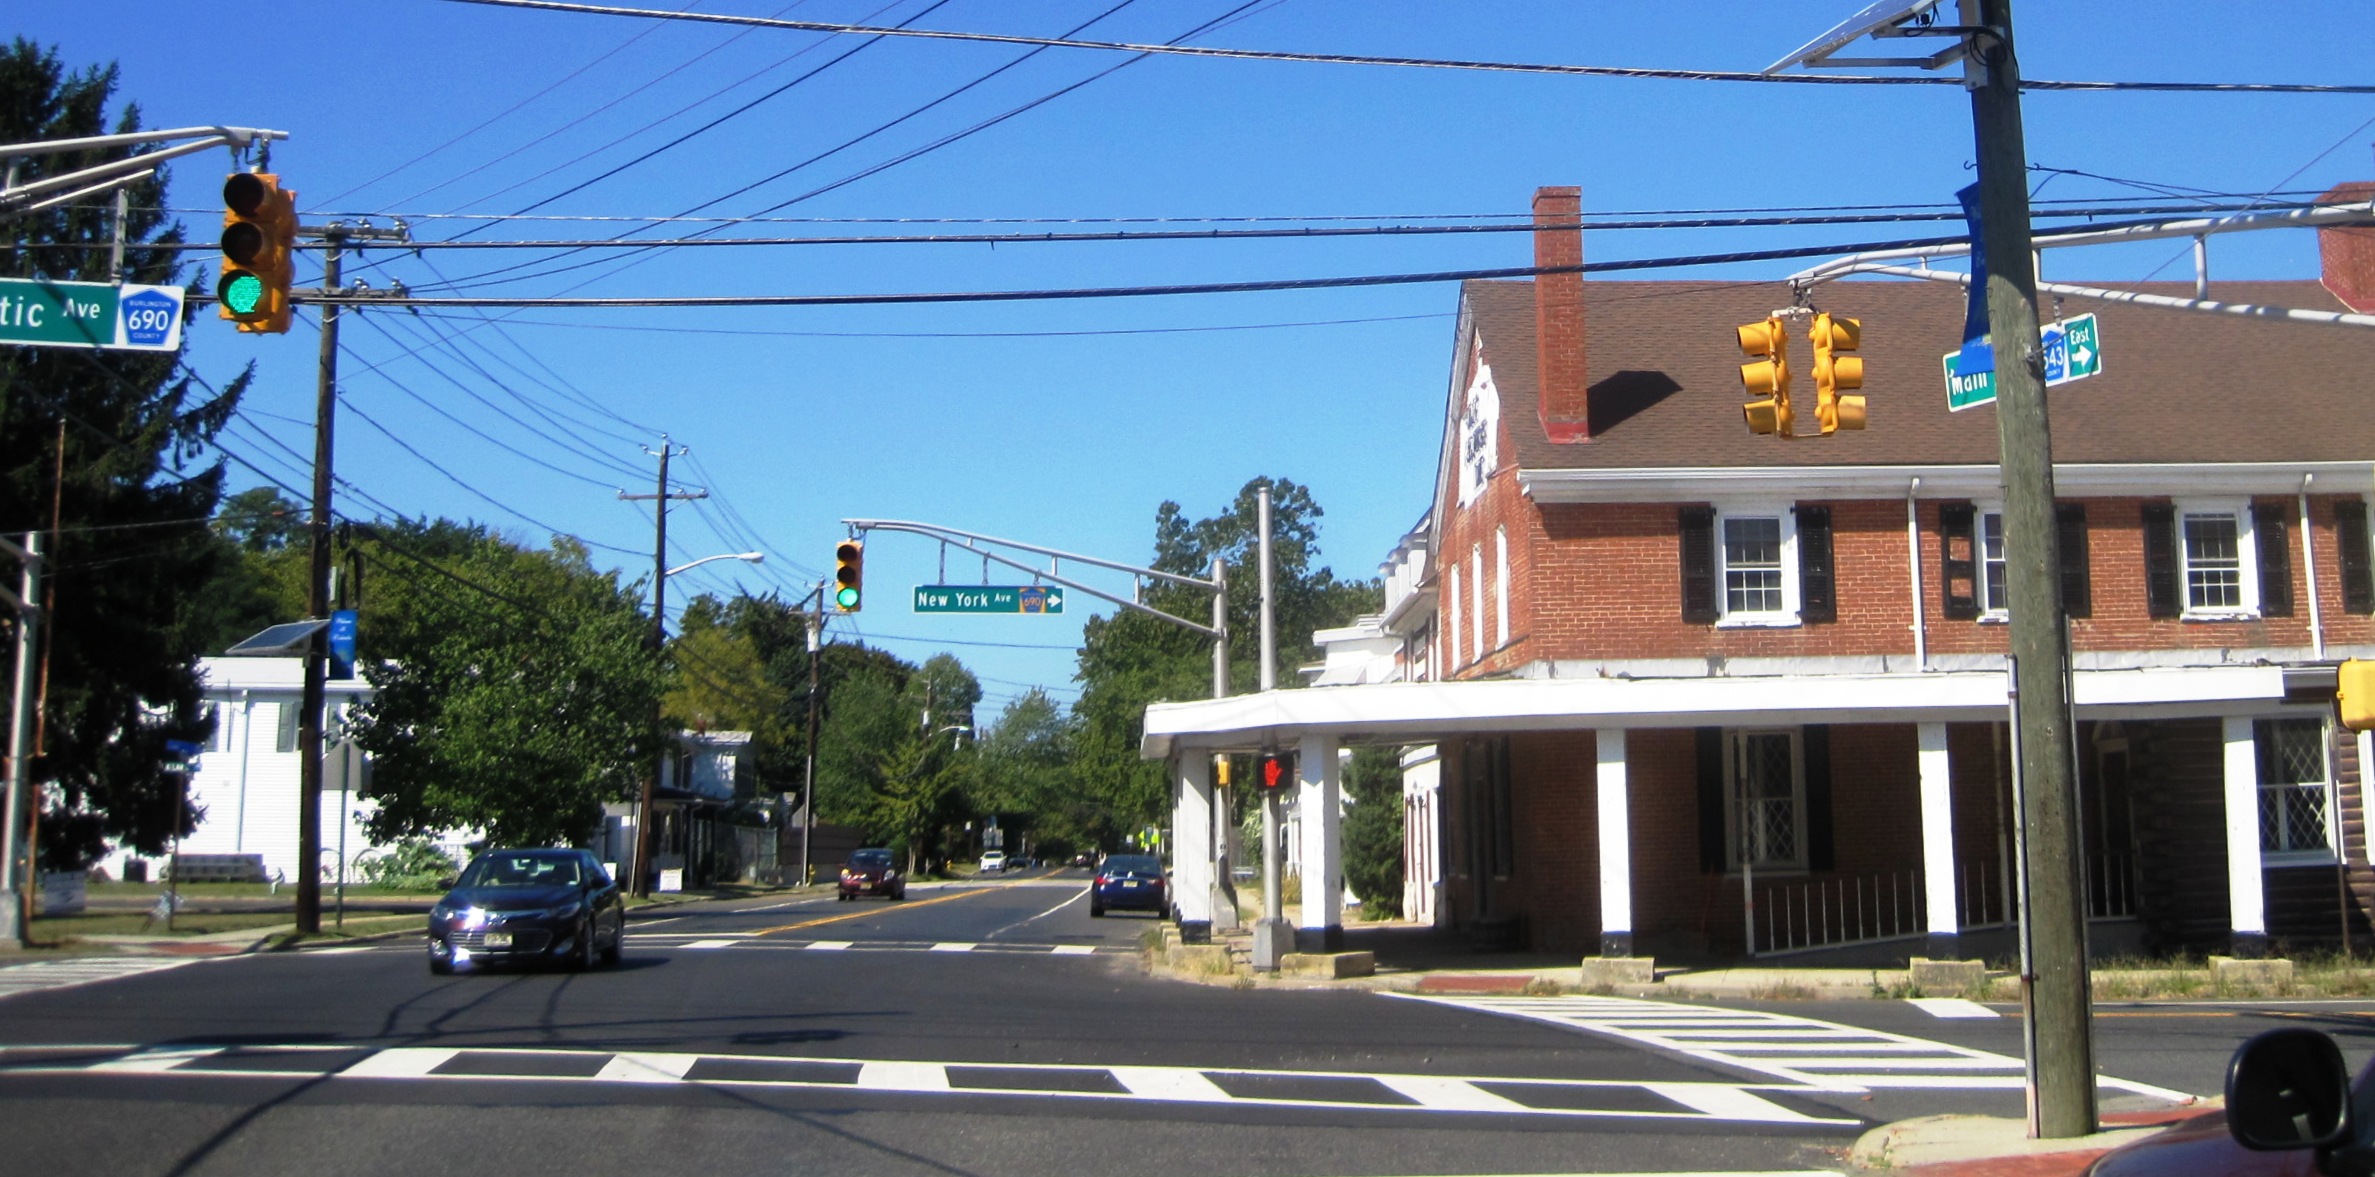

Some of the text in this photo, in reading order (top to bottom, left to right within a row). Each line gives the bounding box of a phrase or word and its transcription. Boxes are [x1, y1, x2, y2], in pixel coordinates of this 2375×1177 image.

[63, 298, 100, 318] Ave
[129, 300, 172, 308] BURLINGTON
[128, 310, 169, 331] 690
[2070, 327, 2090, 345] East
[918, 592, 1011, 607] New York Ave
[1024, 597, 1041, 606] 690
